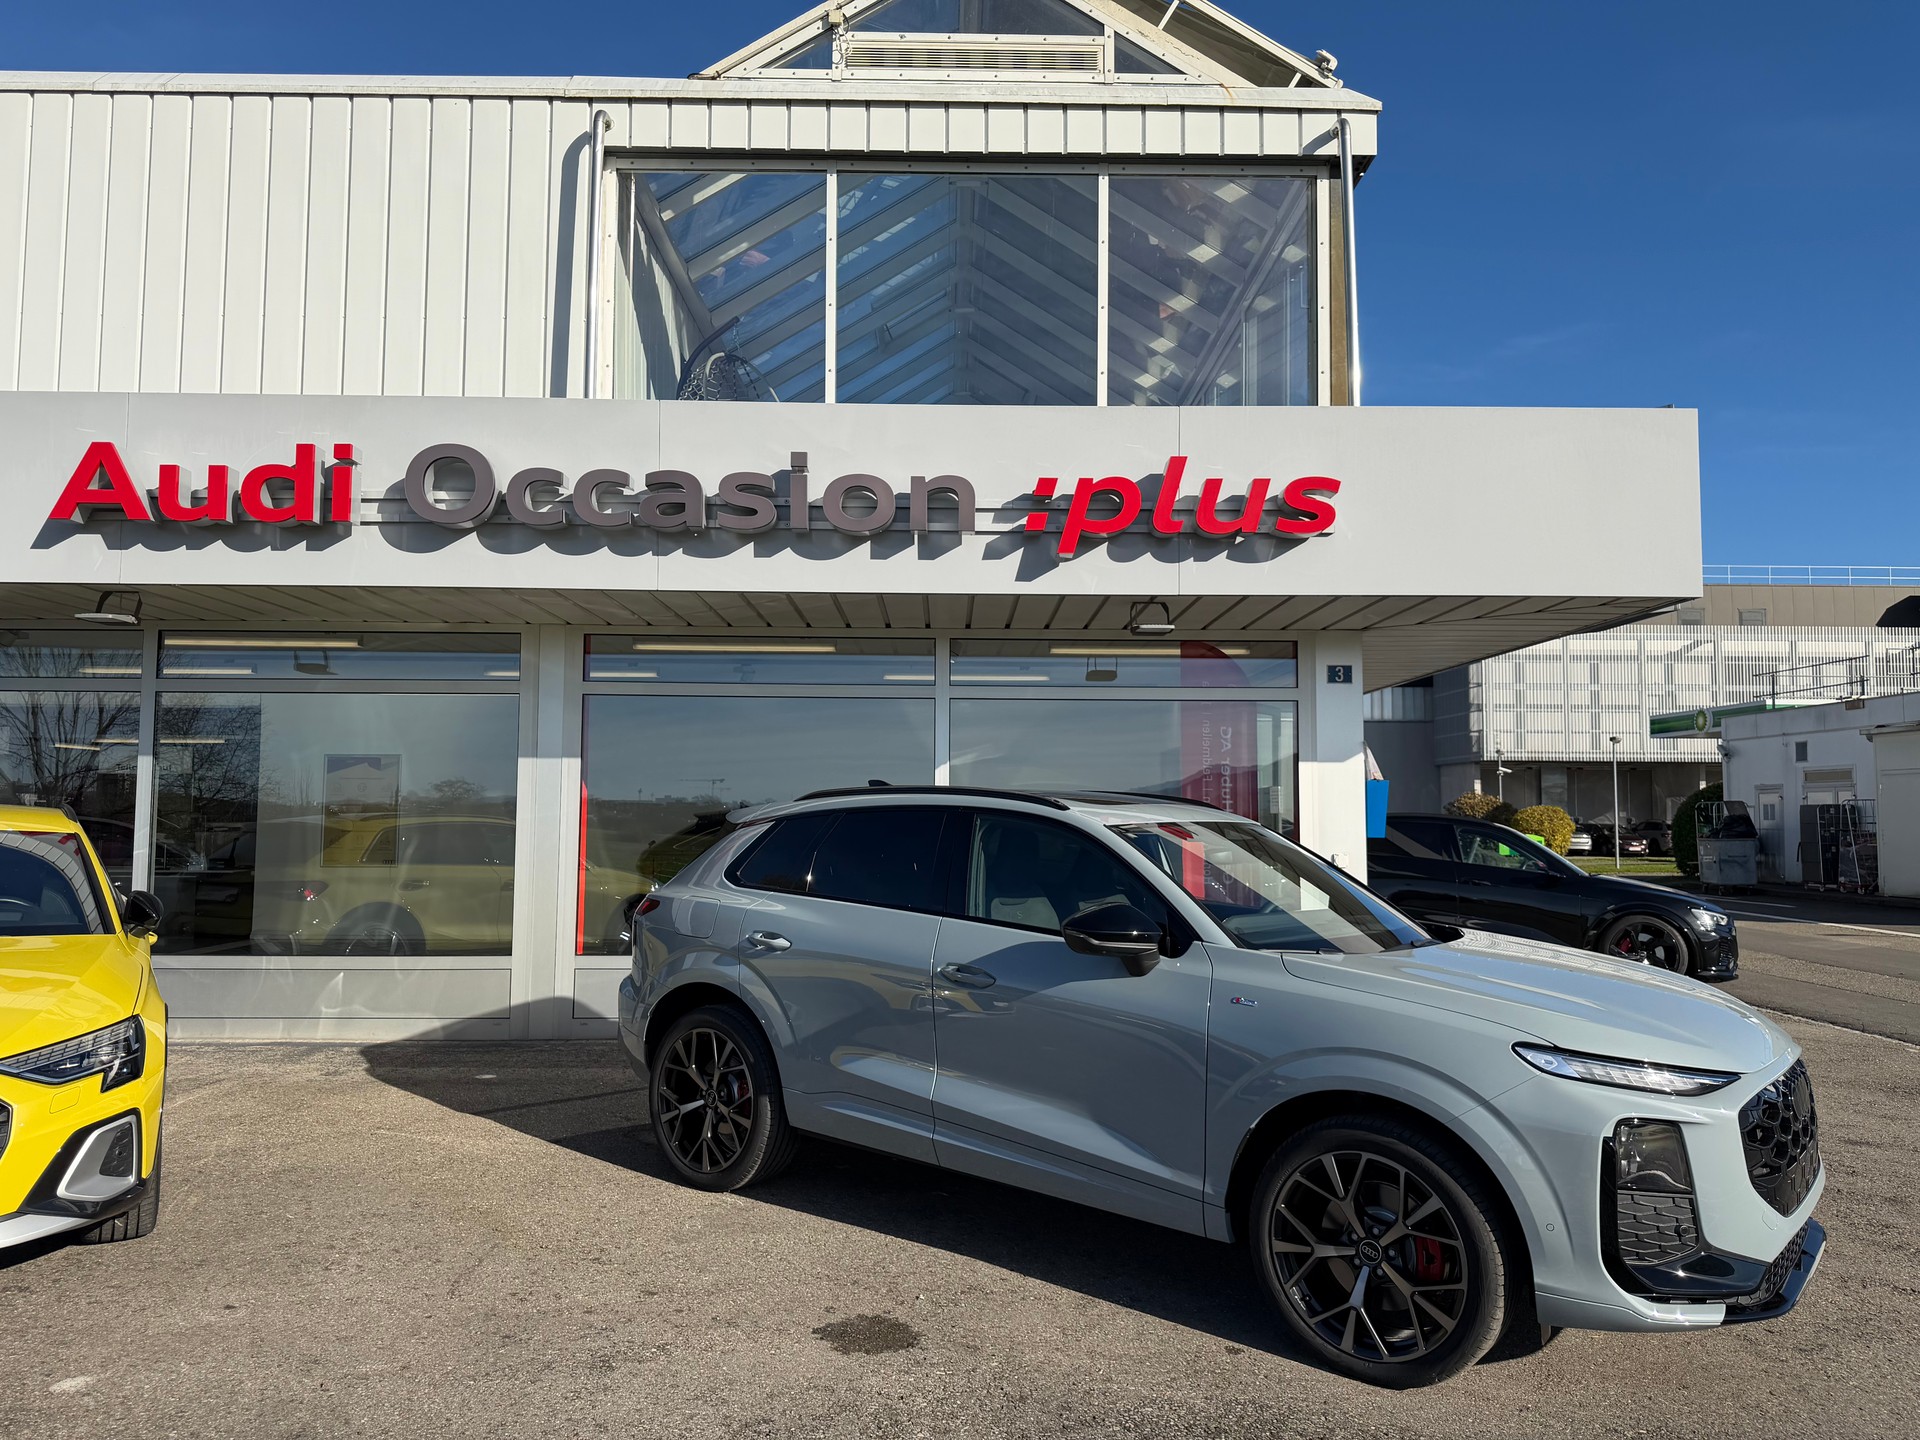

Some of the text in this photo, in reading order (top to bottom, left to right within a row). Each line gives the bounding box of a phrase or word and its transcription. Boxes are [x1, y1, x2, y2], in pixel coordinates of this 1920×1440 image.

[49, 441, 357, 523] Audi
[403, 443, 976, 530] Occasion
[1335, 666, 1344, 682] 3
